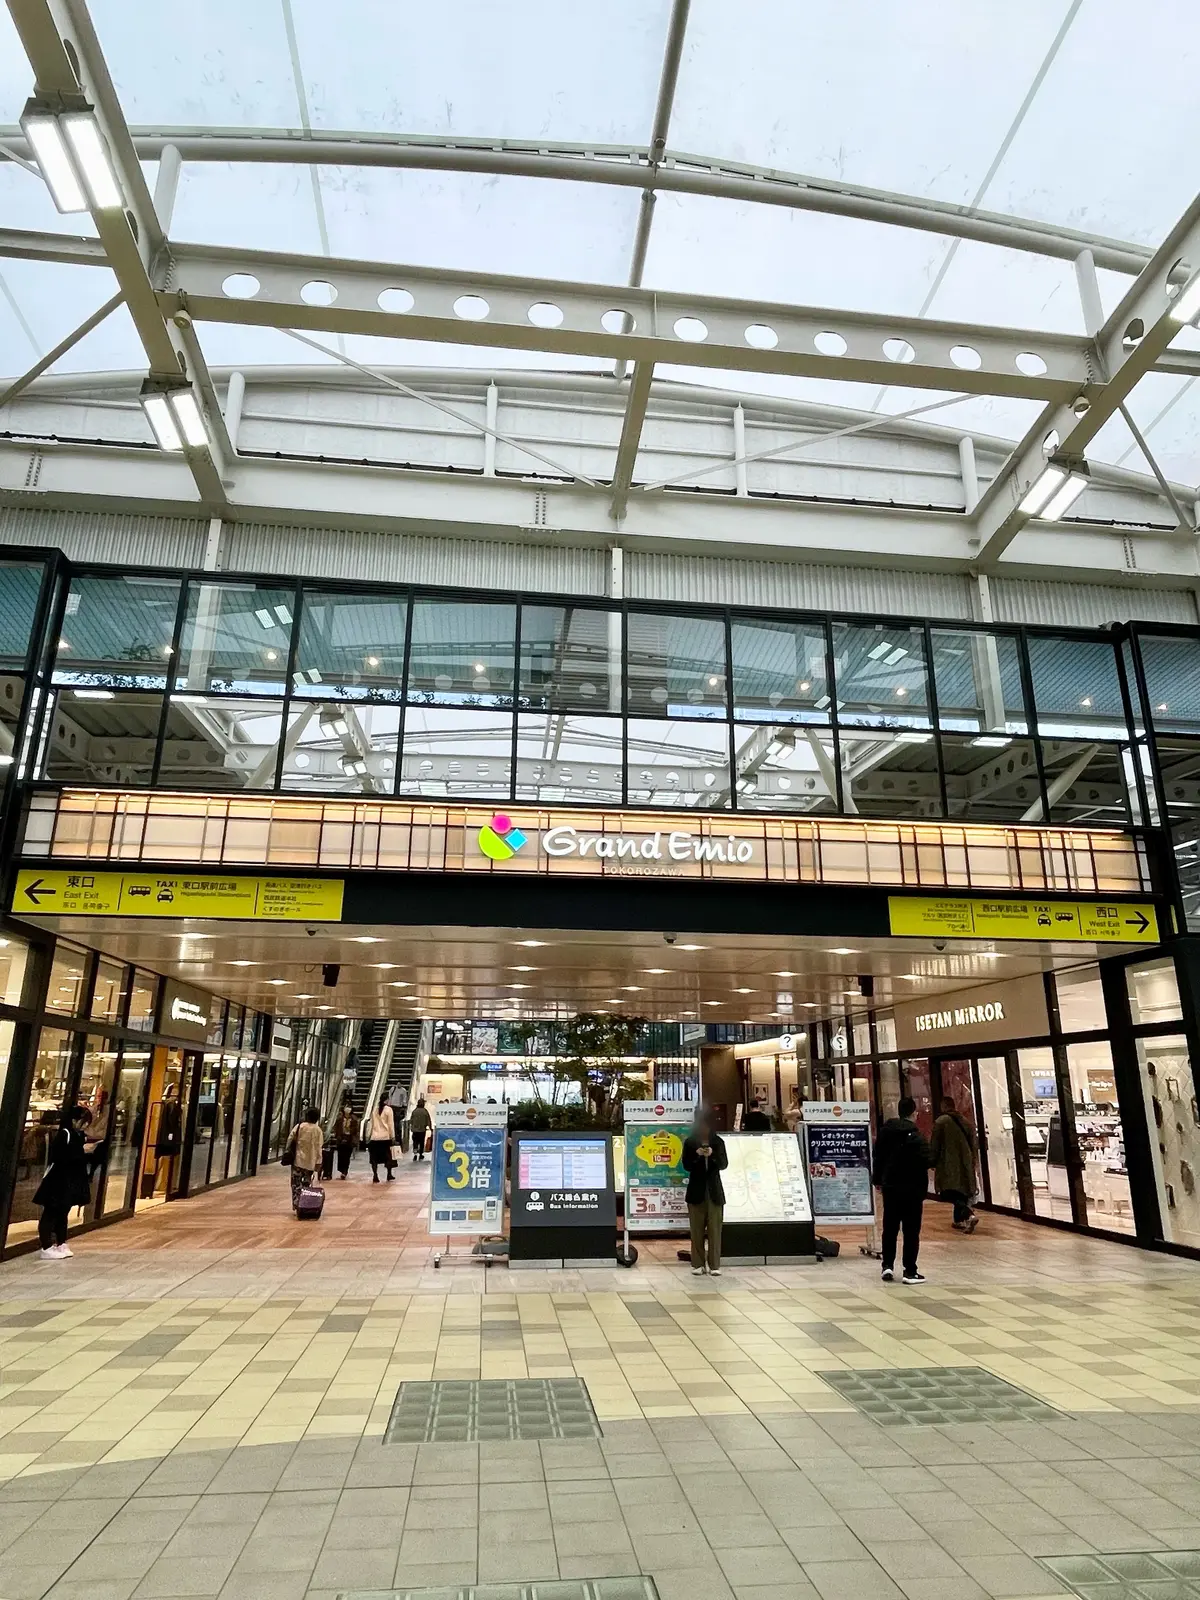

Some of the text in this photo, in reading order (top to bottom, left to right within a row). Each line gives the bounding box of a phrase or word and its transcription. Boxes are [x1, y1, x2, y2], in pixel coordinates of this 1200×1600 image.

[542, 825, 753, 863] Grand Emio
[602, 866, 684, 877] TOKOROZAWA
[66, 875, 95, 888] 東口
[156, 880, 178, 888] TAXI
[182, 881, 237, 890] 東口駅前広場
[64, 891, 99, 900] East Exit
[982, 903, 1028, 913] 西口駅前広場
[1034, 905, 1051, 913] TAXI
[1096, 906, 1118, 918] 西口
[1089, 920, 1120, 928] West Exit
[915, 1010, 952, 1032] ISETAN
[550, 1193, 598, 1202] バス総合案内
